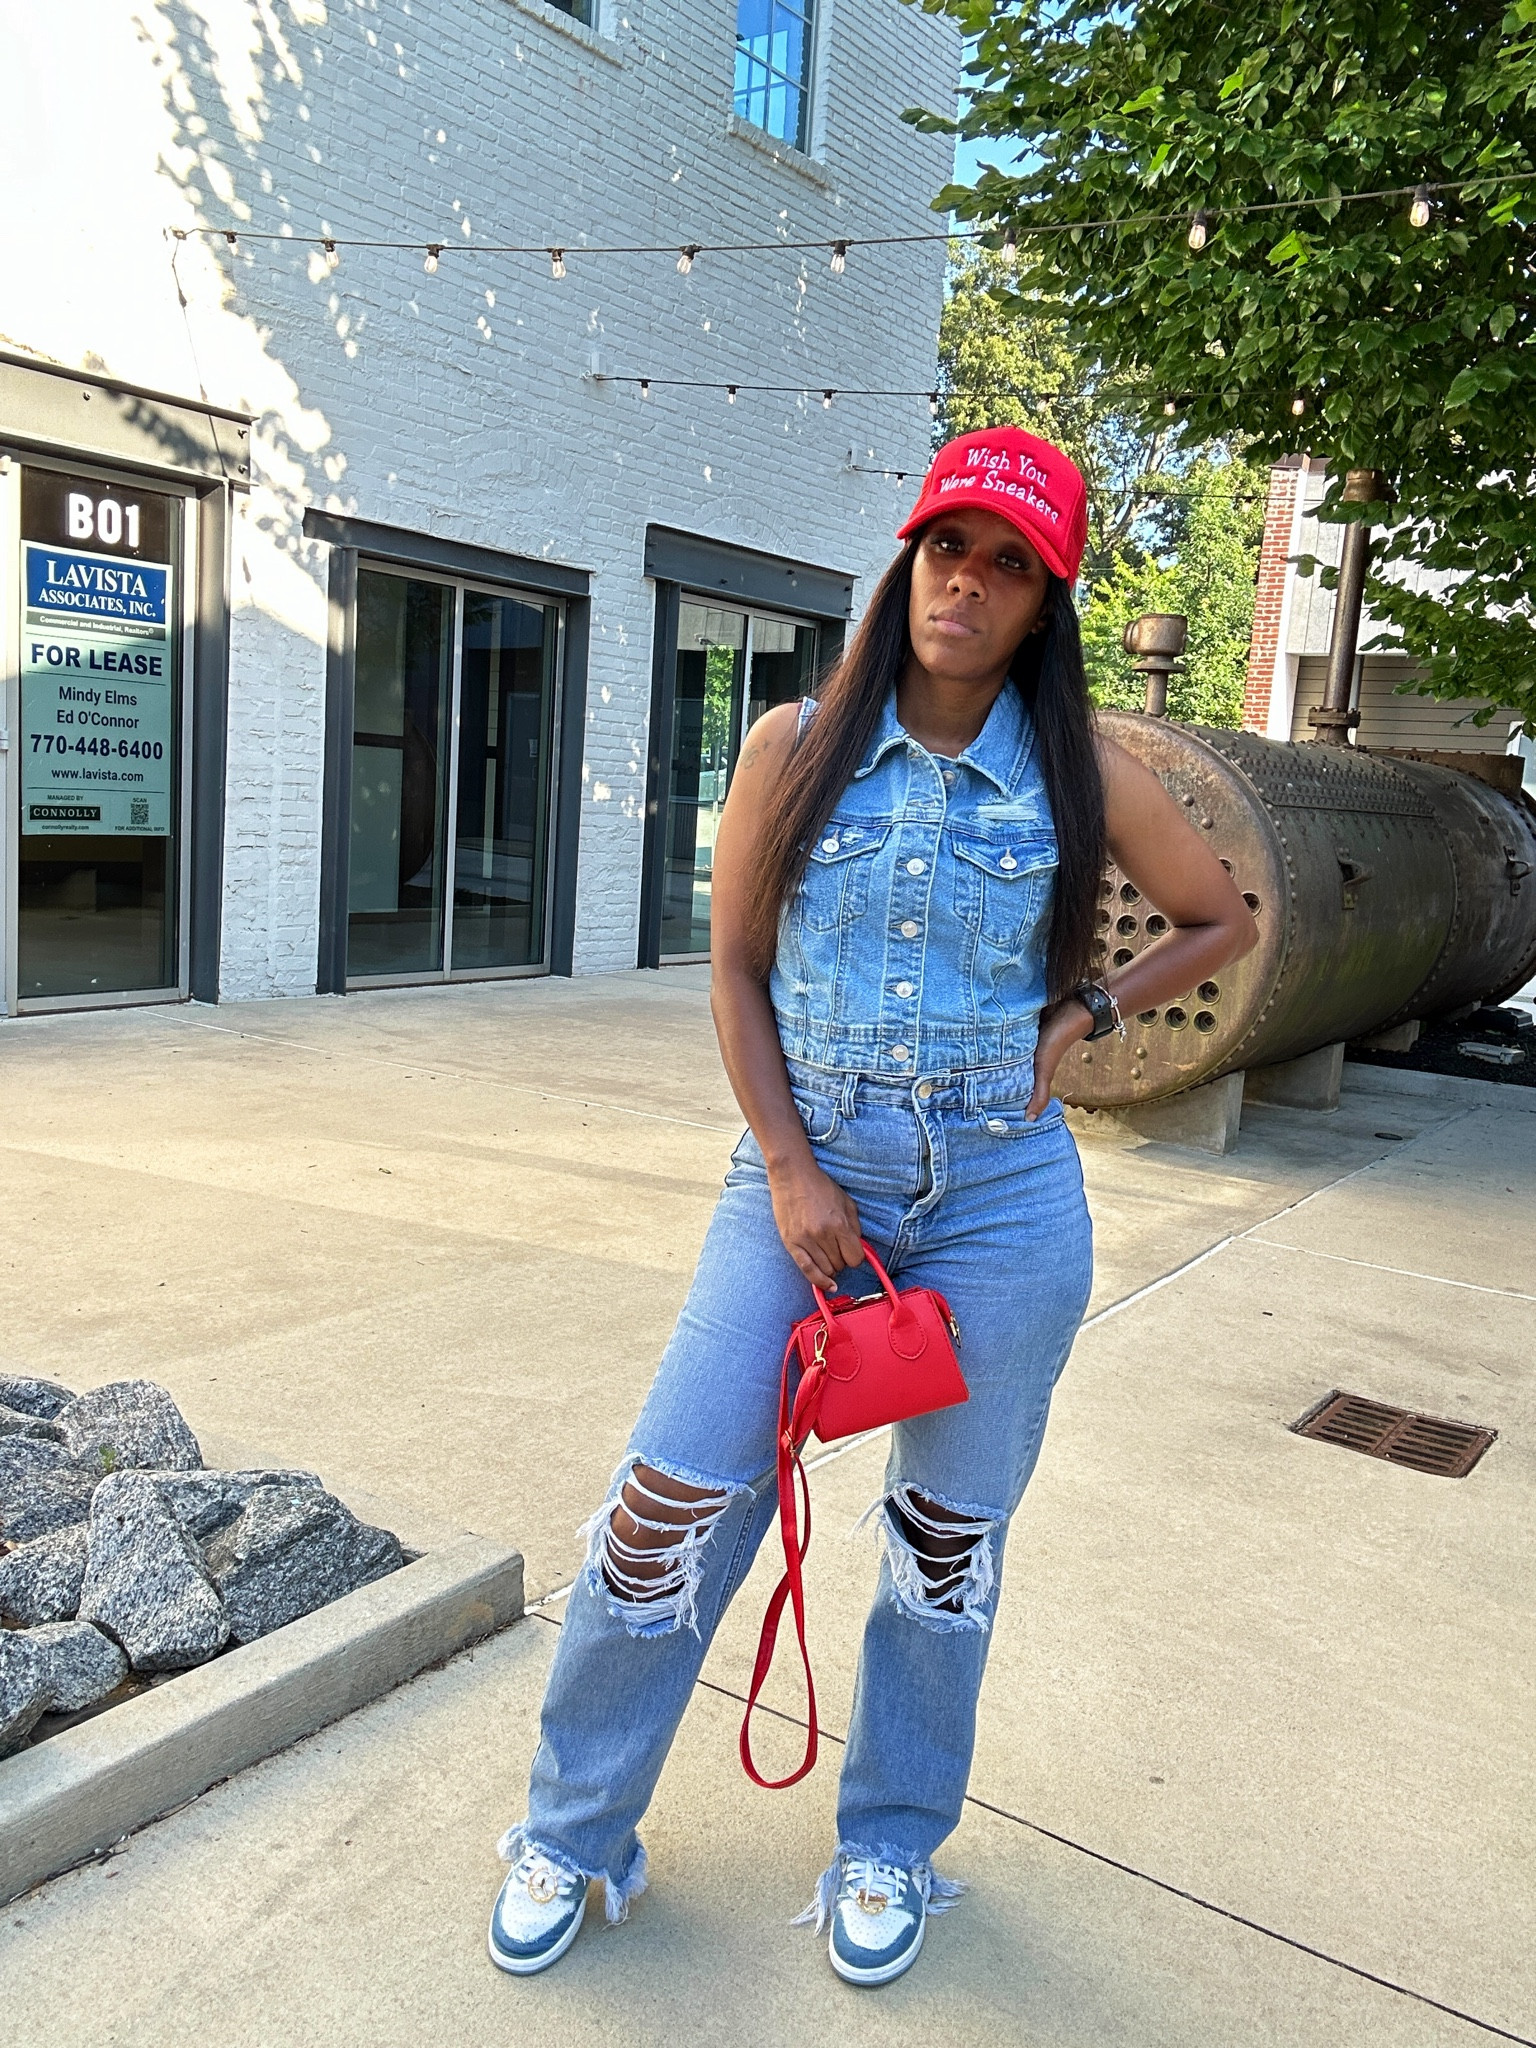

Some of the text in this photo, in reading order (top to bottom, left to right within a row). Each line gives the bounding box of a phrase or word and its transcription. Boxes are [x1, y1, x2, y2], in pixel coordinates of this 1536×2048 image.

[966, 447, 1048, 488] Wish You
[939, 469, 1059, 525] Were Sneakers
[46, 559, 148, 598] LAVISTA
[38, 587, 157, 618] ASSOCIATES, INC.
[39, 615, 79, 627] Commercial
[79, 621, 92, 629] and
[31, 642, 163, 677] FOR LEASE
[58, 685, 138, 706] Mindy Elms
[56, 709, 140, 729] Ed O'Connor
[30, 733, 164, 760] 770-448-6400
[51, 767, 145, 782] www.lavista.com
[33, 807, 98, 818] CONNOLLY
